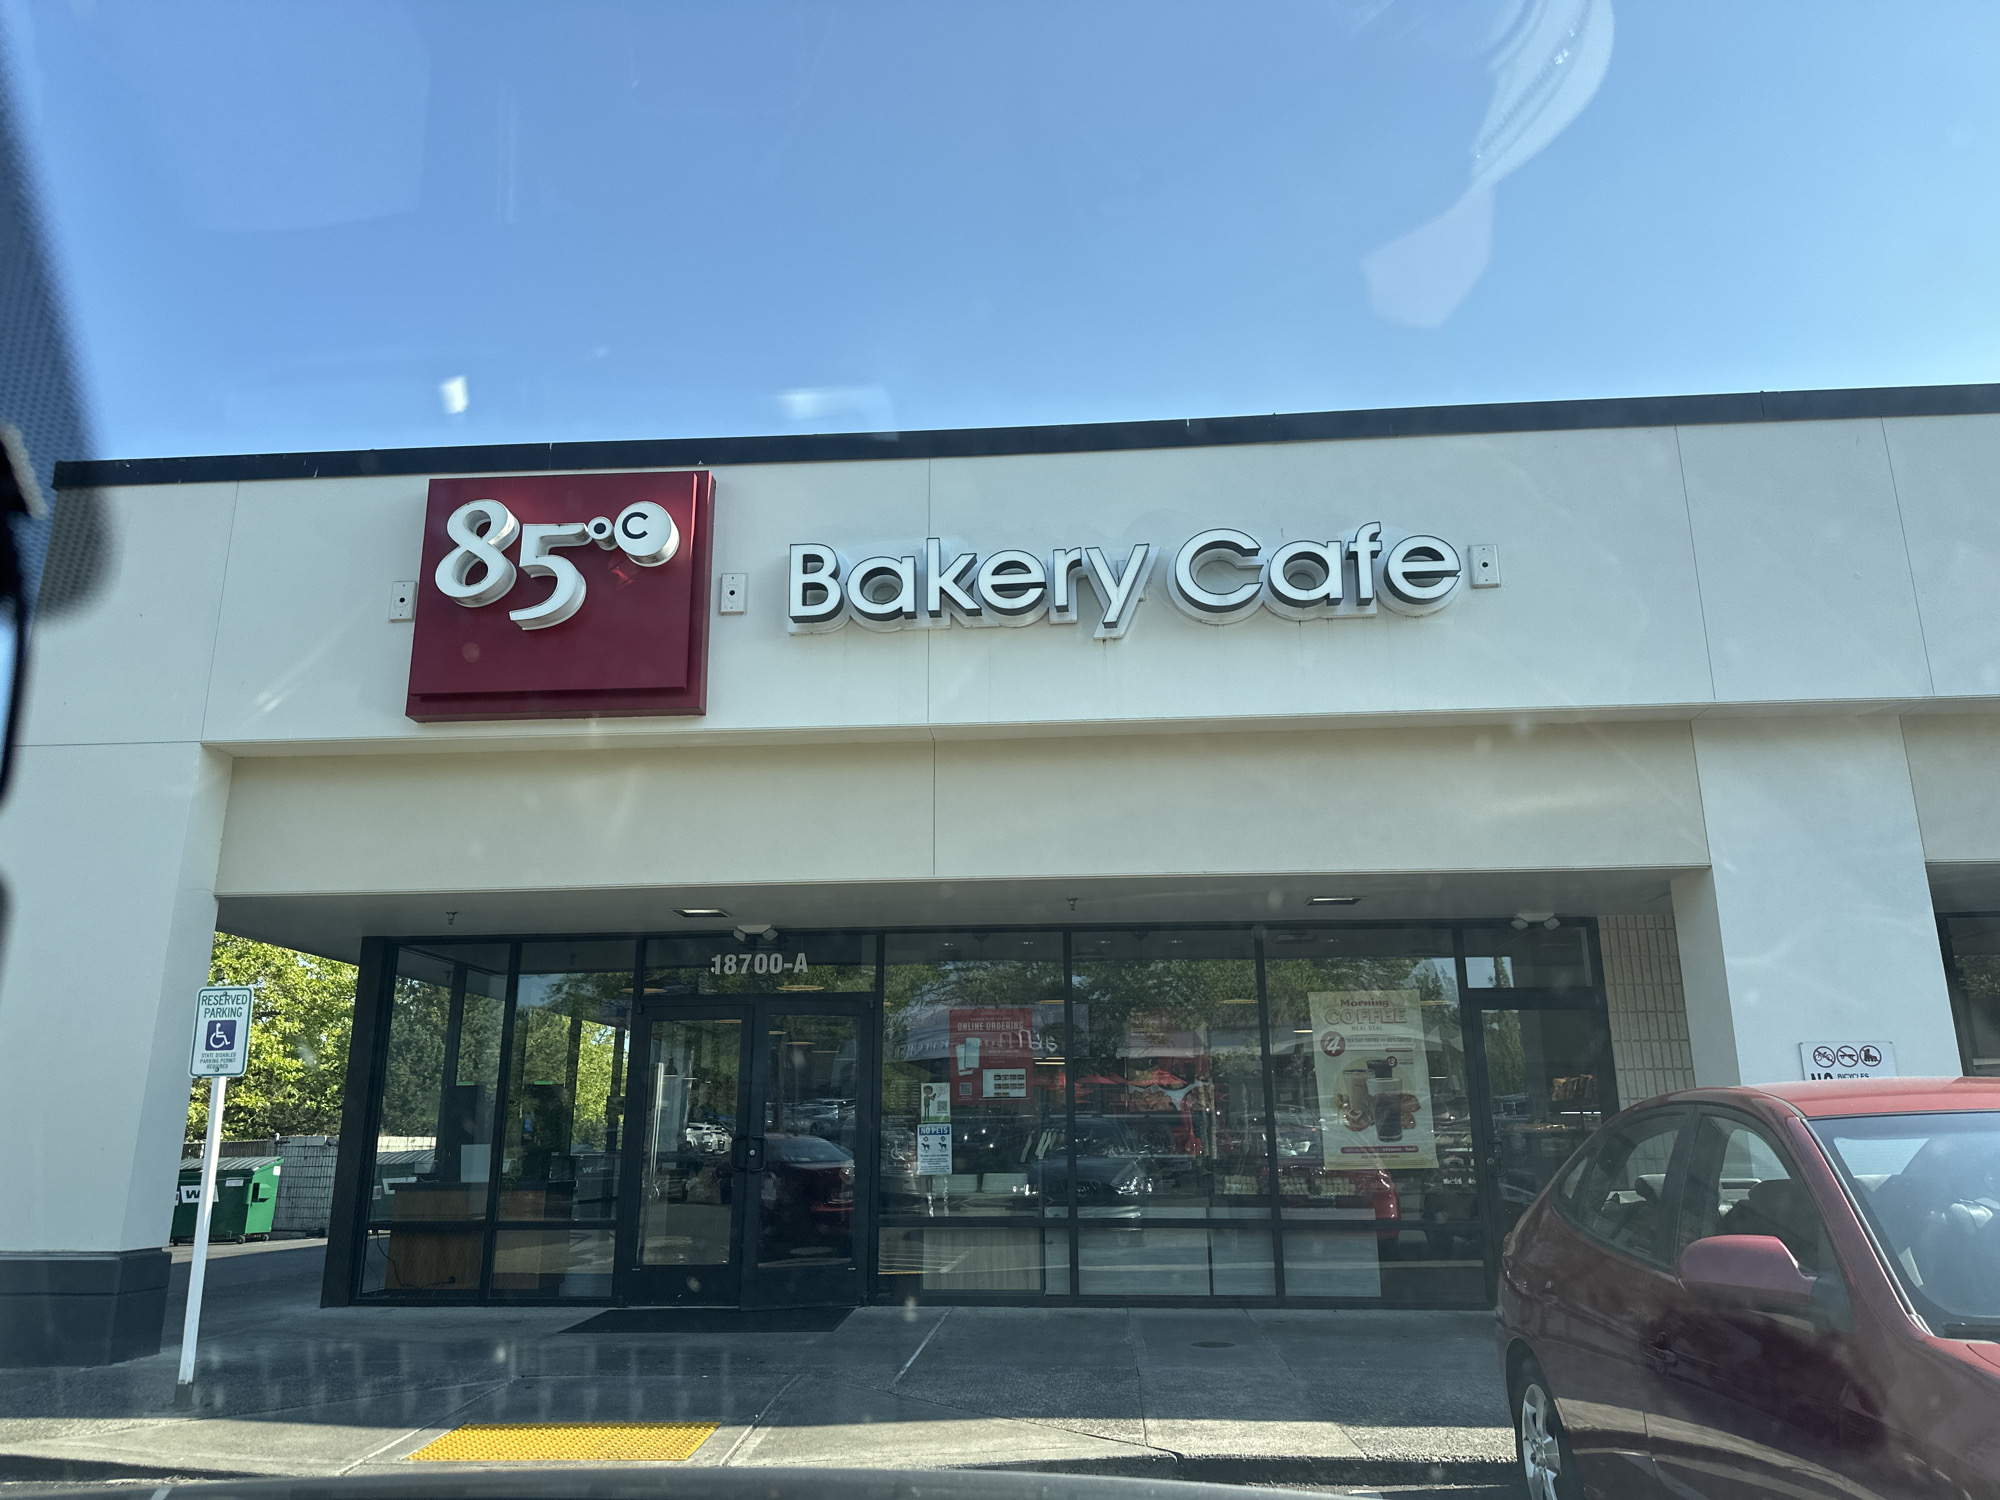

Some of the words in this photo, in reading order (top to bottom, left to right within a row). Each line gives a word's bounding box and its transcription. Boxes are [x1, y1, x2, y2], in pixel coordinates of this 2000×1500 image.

[787, 536, 1152, 637] Bakery
[1172, 520, 1463, 618] Cafe
[711, 952, 809, 975] 18700-A
[201, 994, 248, 1006] RESERVED
[1340, 997, 1390, 1008] Morning
[203, 1007, 243, 1019] PARKING
[1324, 1008, 1408, 1025] COFFEE
[957, 1021, 984, 1031] ONLINE
[986, 1020, 1024, 1031] ORDERING
